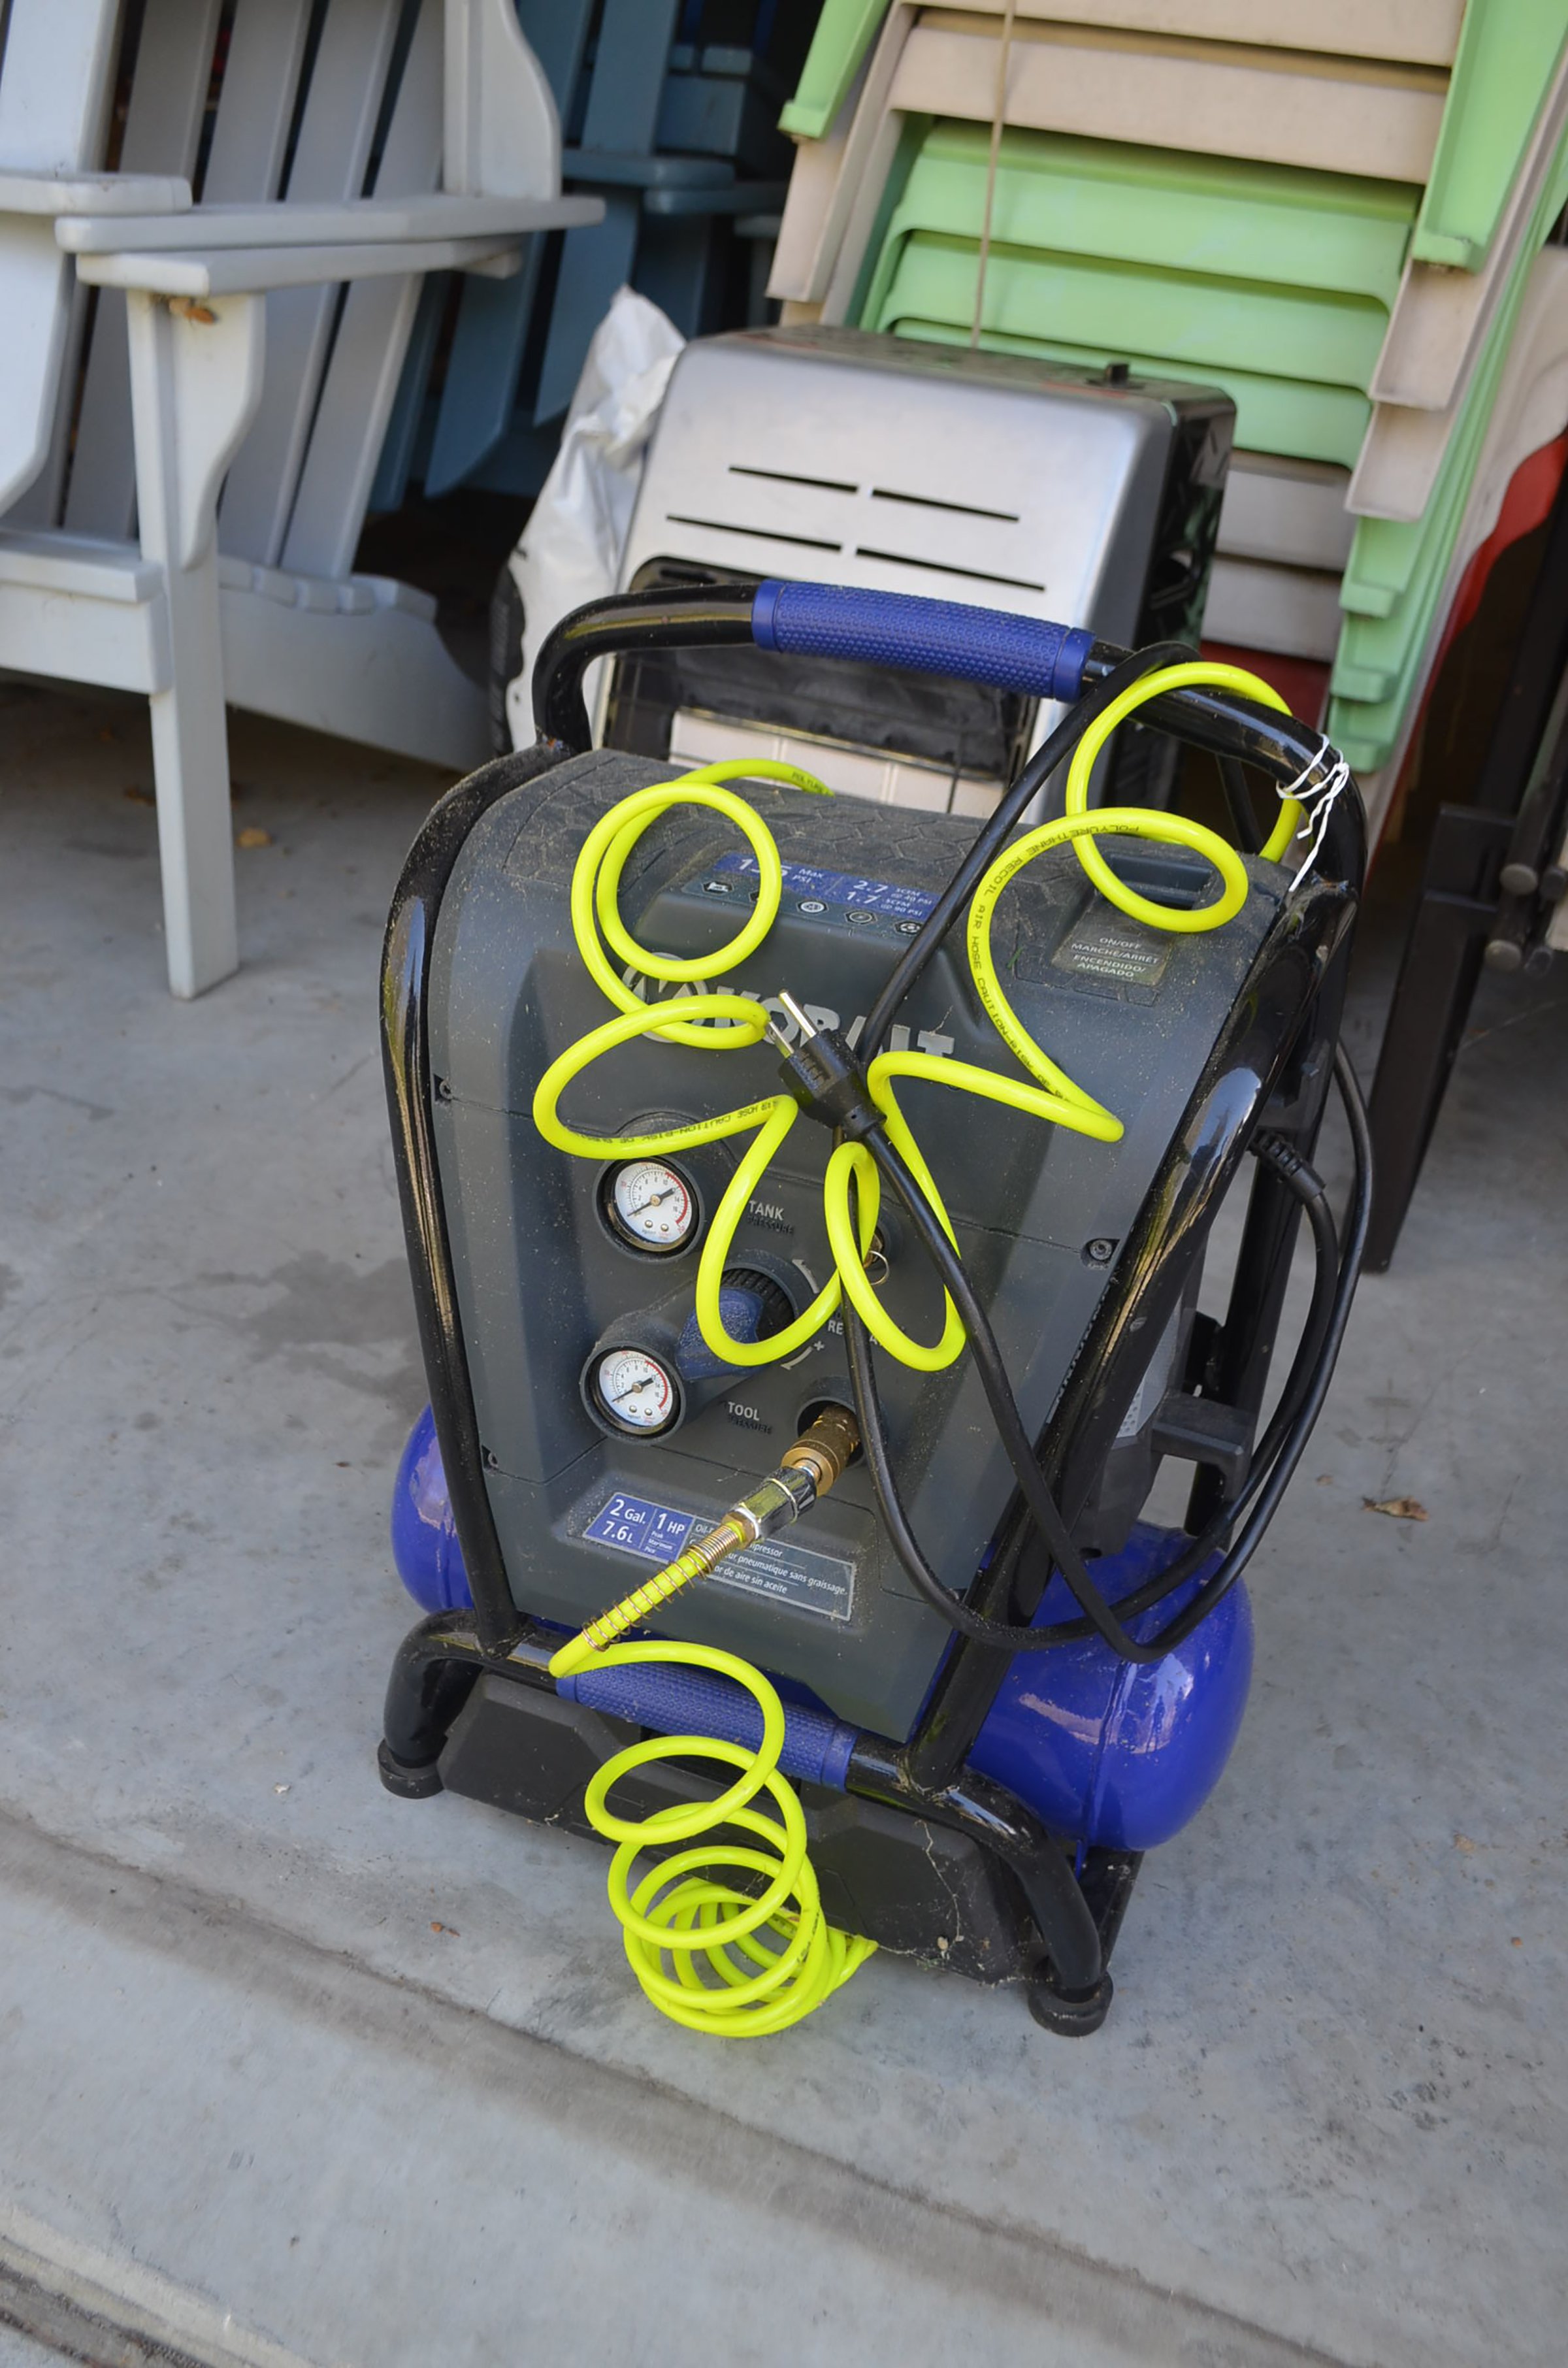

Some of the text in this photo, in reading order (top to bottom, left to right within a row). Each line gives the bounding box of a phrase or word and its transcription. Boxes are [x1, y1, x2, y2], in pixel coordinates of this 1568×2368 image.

[798, 868, 823, 879] Max
[984, 857, 1023, 896] RECOIL
[853, 881, 888, 893] 2.7
[847, 892, 881, 904] 1.7
[973, 904, 985, 929] AIR
[972, 936, 982, 970] HOSE
[1071, 944, 1158, 964] MARCHE/ARRÊT
[1100, 937, 1141, 950] ON/OFF
[1073, 954, 1147, 973] ENCENDIDO/
[1077, 962, 1134, 978] APAGADO
[749, 1200, 784, 1221] TANK
[728, 1401, 760, 1421] TOOL
[610, 1499, 646, 1524] 2 Gal.
[602, 1521, 633, 1543] 7.6 L
[657, 1513, 685, 1534] 1 HP
[738, 1556, 788, 1577] pneumatique
[789, 1571, 808, 1583] sans
[724, 1568, 735, 1577] de
[734, 1571, 751, 1581] aire
[751, 1576, 763, 1586] sin
[763, 1580, 788, 1594] aceite
